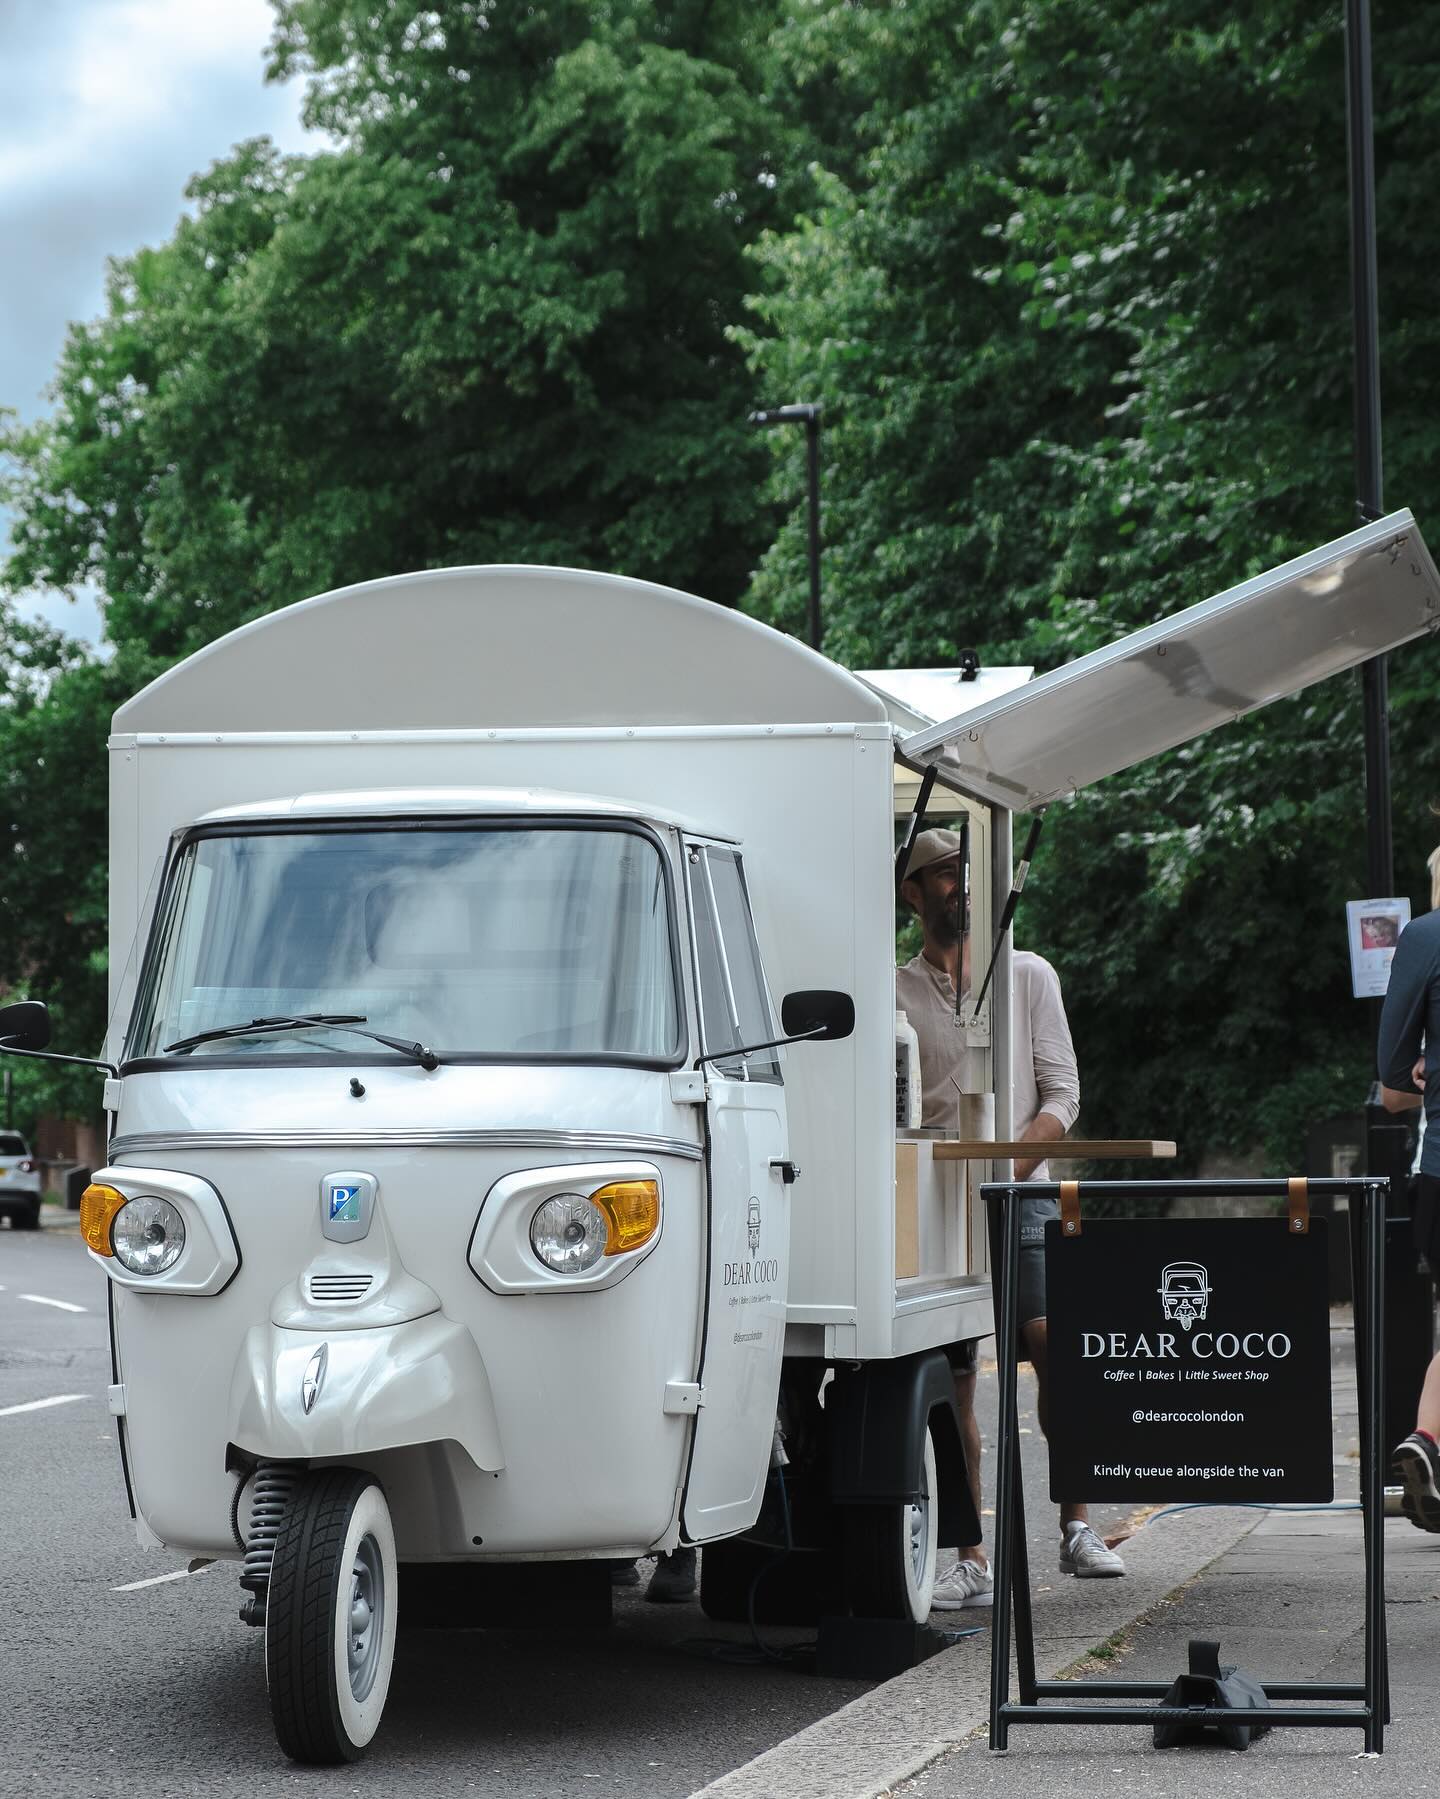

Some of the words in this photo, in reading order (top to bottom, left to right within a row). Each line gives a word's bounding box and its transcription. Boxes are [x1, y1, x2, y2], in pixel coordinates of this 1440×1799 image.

[724, 1262, 751, 1286] DEAR
[754, 1259, 778, 1284] COCO
[1081, 1333, 1180, 1358] DEAR
[1191, 1333, 1292, 1358] COCO
[1103, 1370, 1135, 1382] Coffee
[1145, 1370, 1175, 1380] Bakes
[1185, 1370, 1210, 1381] Little
[1212, 1370, 1242, 1381] Sweet
[1244, 1370, 1270, 1382] Shop
[1132, 1410, 1245, 1424] @dearcocolondon
[1093, 1464, 1132, 1479] Kindly
[1134, 1467, 1173, 1479] queue
[1176, 1465, 1235, 1480] alongside
[1238, 1466, 1259, 1478] the
[1262, 1468, 1285, 1478] van
